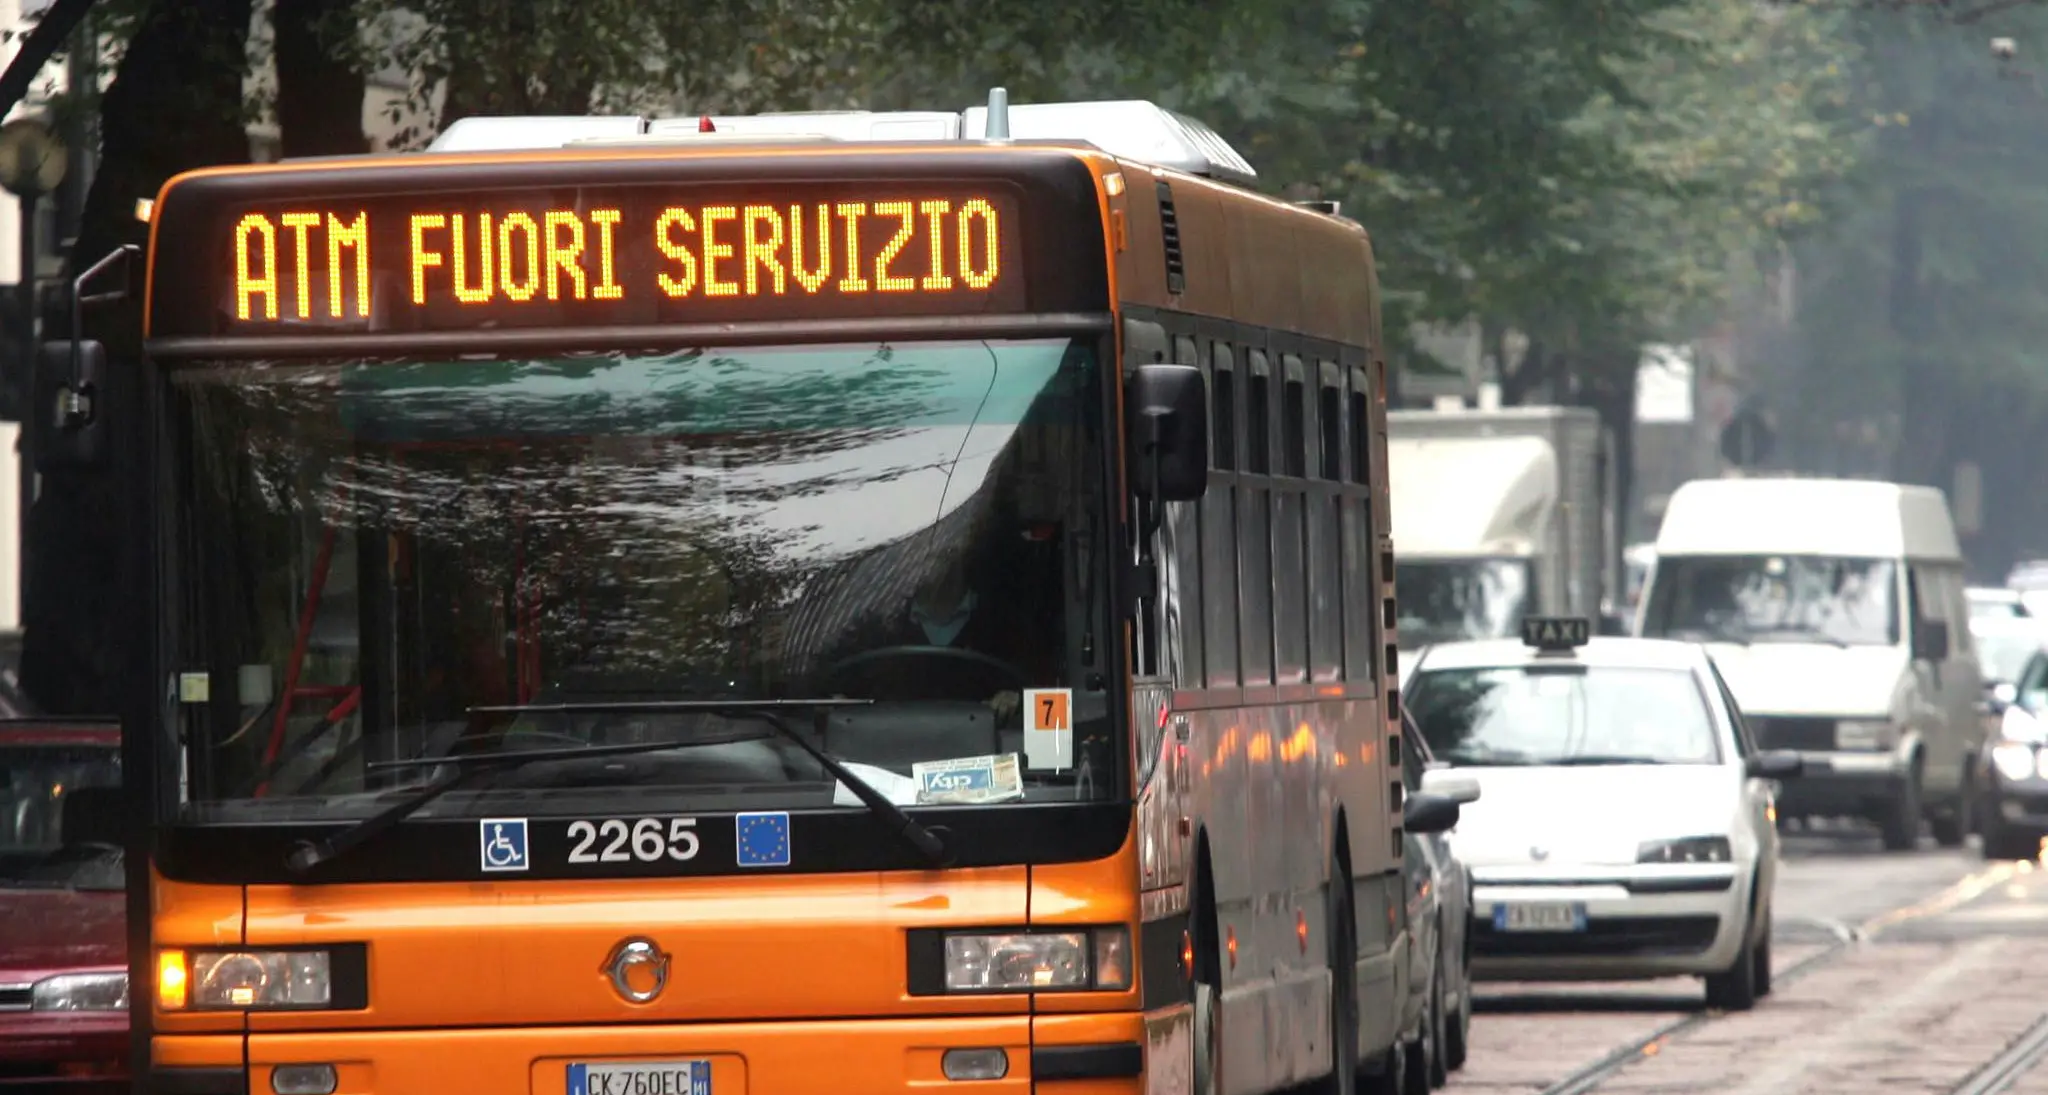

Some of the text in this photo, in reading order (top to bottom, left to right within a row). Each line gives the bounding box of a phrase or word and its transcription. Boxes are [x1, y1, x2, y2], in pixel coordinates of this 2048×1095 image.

[234, 199, 998, 320] ATM FUORI SERVIZIO
[1527, 620, 1585, 641] TAXI
[1042, 700, 1054, 726] 7
[930, 772, 972, 791] city
[567, 817, 700, 863] 2265
